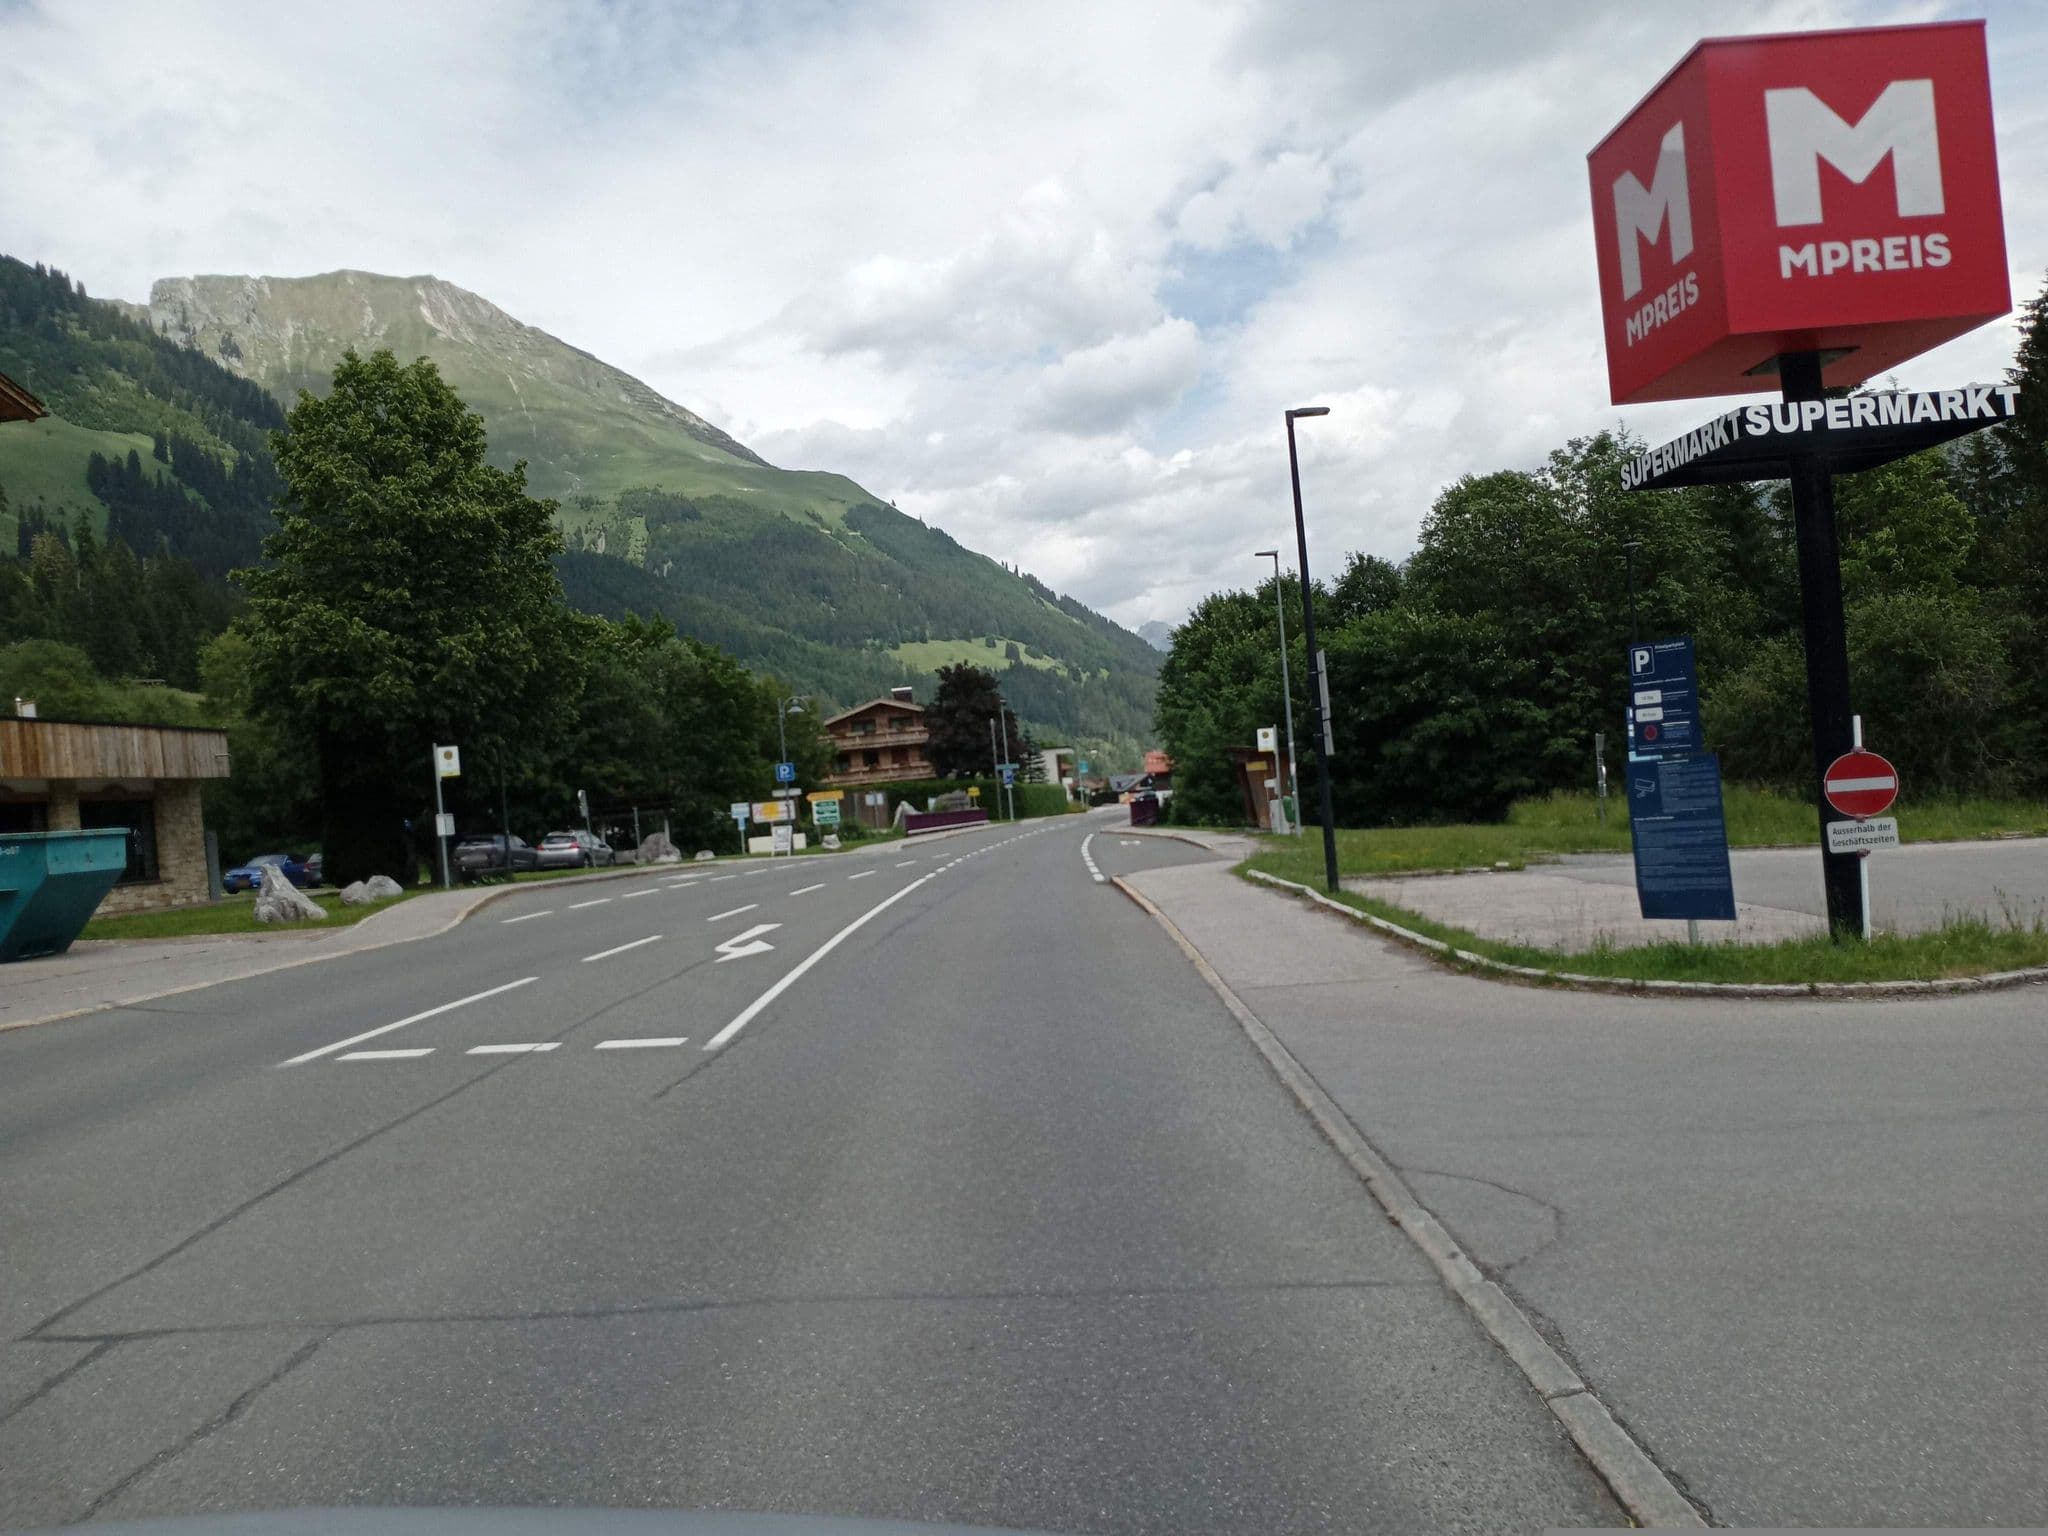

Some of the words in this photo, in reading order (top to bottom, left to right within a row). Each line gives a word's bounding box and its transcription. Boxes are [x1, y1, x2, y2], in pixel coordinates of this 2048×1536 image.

[1764, 78, 1945, 228] M
[1612, 120, 1694, 302] M
[1779, 233, 1952, 279] MPREIS
[1626, 271, 1699, 347] MPREIS
[1745, 385, 2020, 437] SUPERMARKT
[1620, 413, 1742, 491] SUPERMARKT
[1634, 650, 1650, 673] P
[1832, 824, 1875, 835] Ausserhalb
[1878, 823, 1892, 832] der
